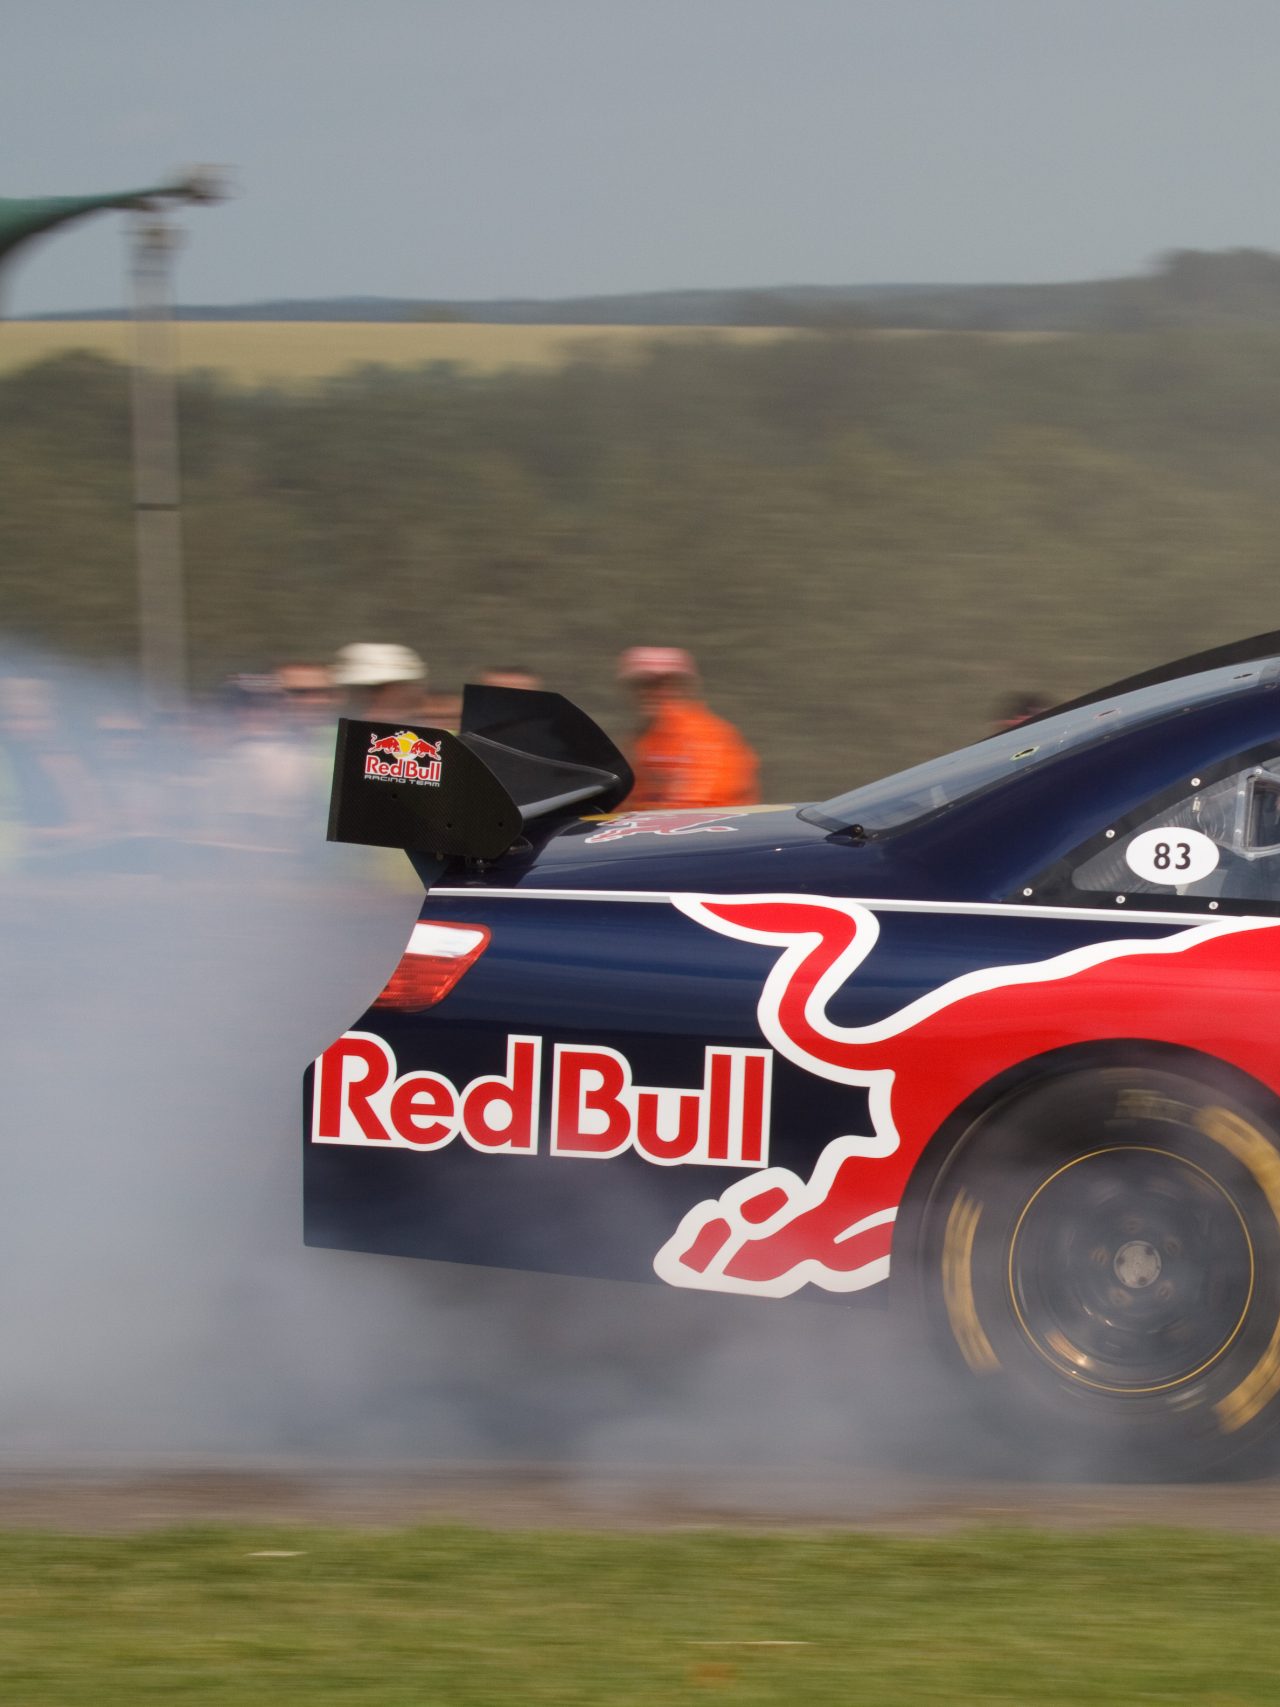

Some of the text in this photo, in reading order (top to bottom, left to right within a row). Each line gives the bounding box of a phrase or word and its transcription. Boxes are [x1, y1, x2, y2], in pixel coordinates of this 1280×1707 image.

[364, 774, 440, 788] RACING TEAM
[365, 755, 442, 781] Red Bull
[1153, 842, 1191, 870] 83
[312, 1031, 773, 1168] Red Bull
